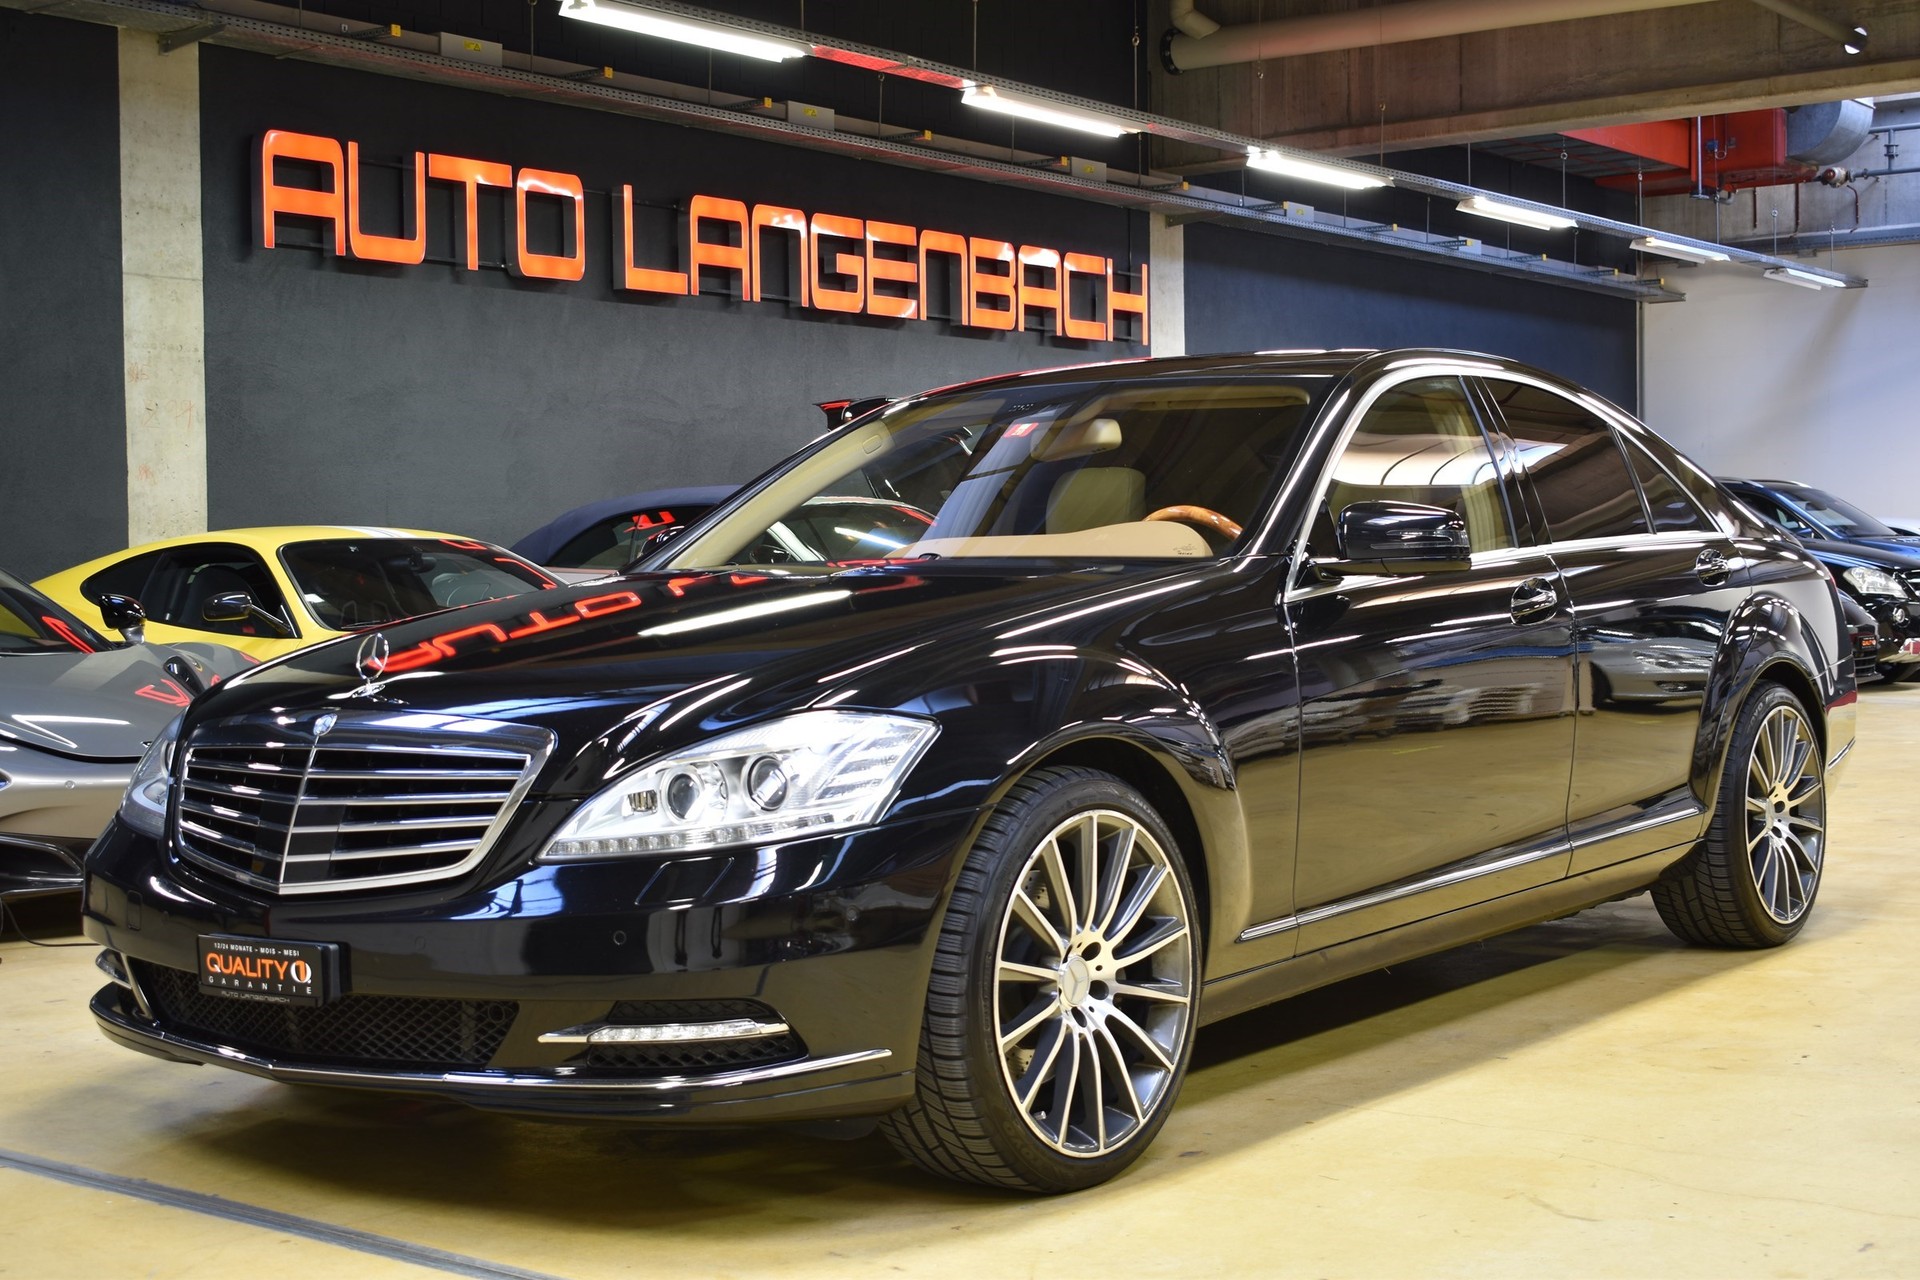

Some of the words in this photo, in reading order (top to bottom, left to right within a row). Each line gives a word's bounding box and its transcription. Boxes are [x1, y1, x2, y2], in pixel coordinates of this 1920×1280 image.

[263, 129, 585, 281] AUTO
[623, 184, 1148, 345] LANGENBACH
[214, 942, 229, 950] 12/24
[230, 945, 253, 953] MONATE
[260, 947, 276, 955] MOIS
[283, 949, 300, 957] MESI
[206, 952, 289, 981] QUALITY
[208, 975, 312, 995] GARANTIE
